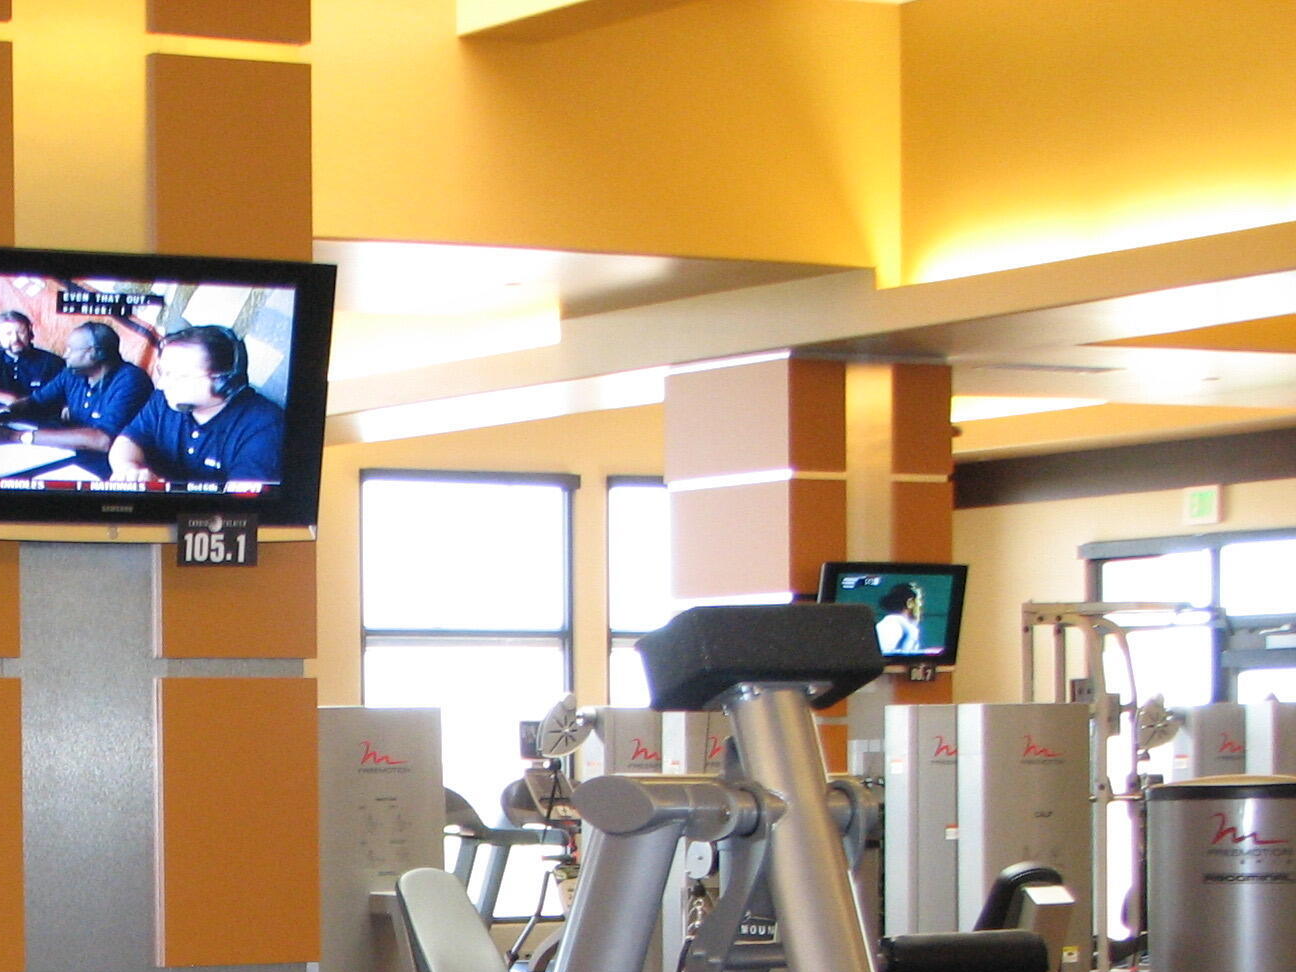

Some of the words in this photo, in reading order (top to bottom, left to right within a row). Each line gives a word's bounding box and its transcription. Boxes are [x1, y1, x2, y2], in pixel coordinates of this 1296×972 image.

[63, 292, 89, 302] EVEN
[95, 293, 120, 303] THAT
[183, 532, 246, 563] 105.1
